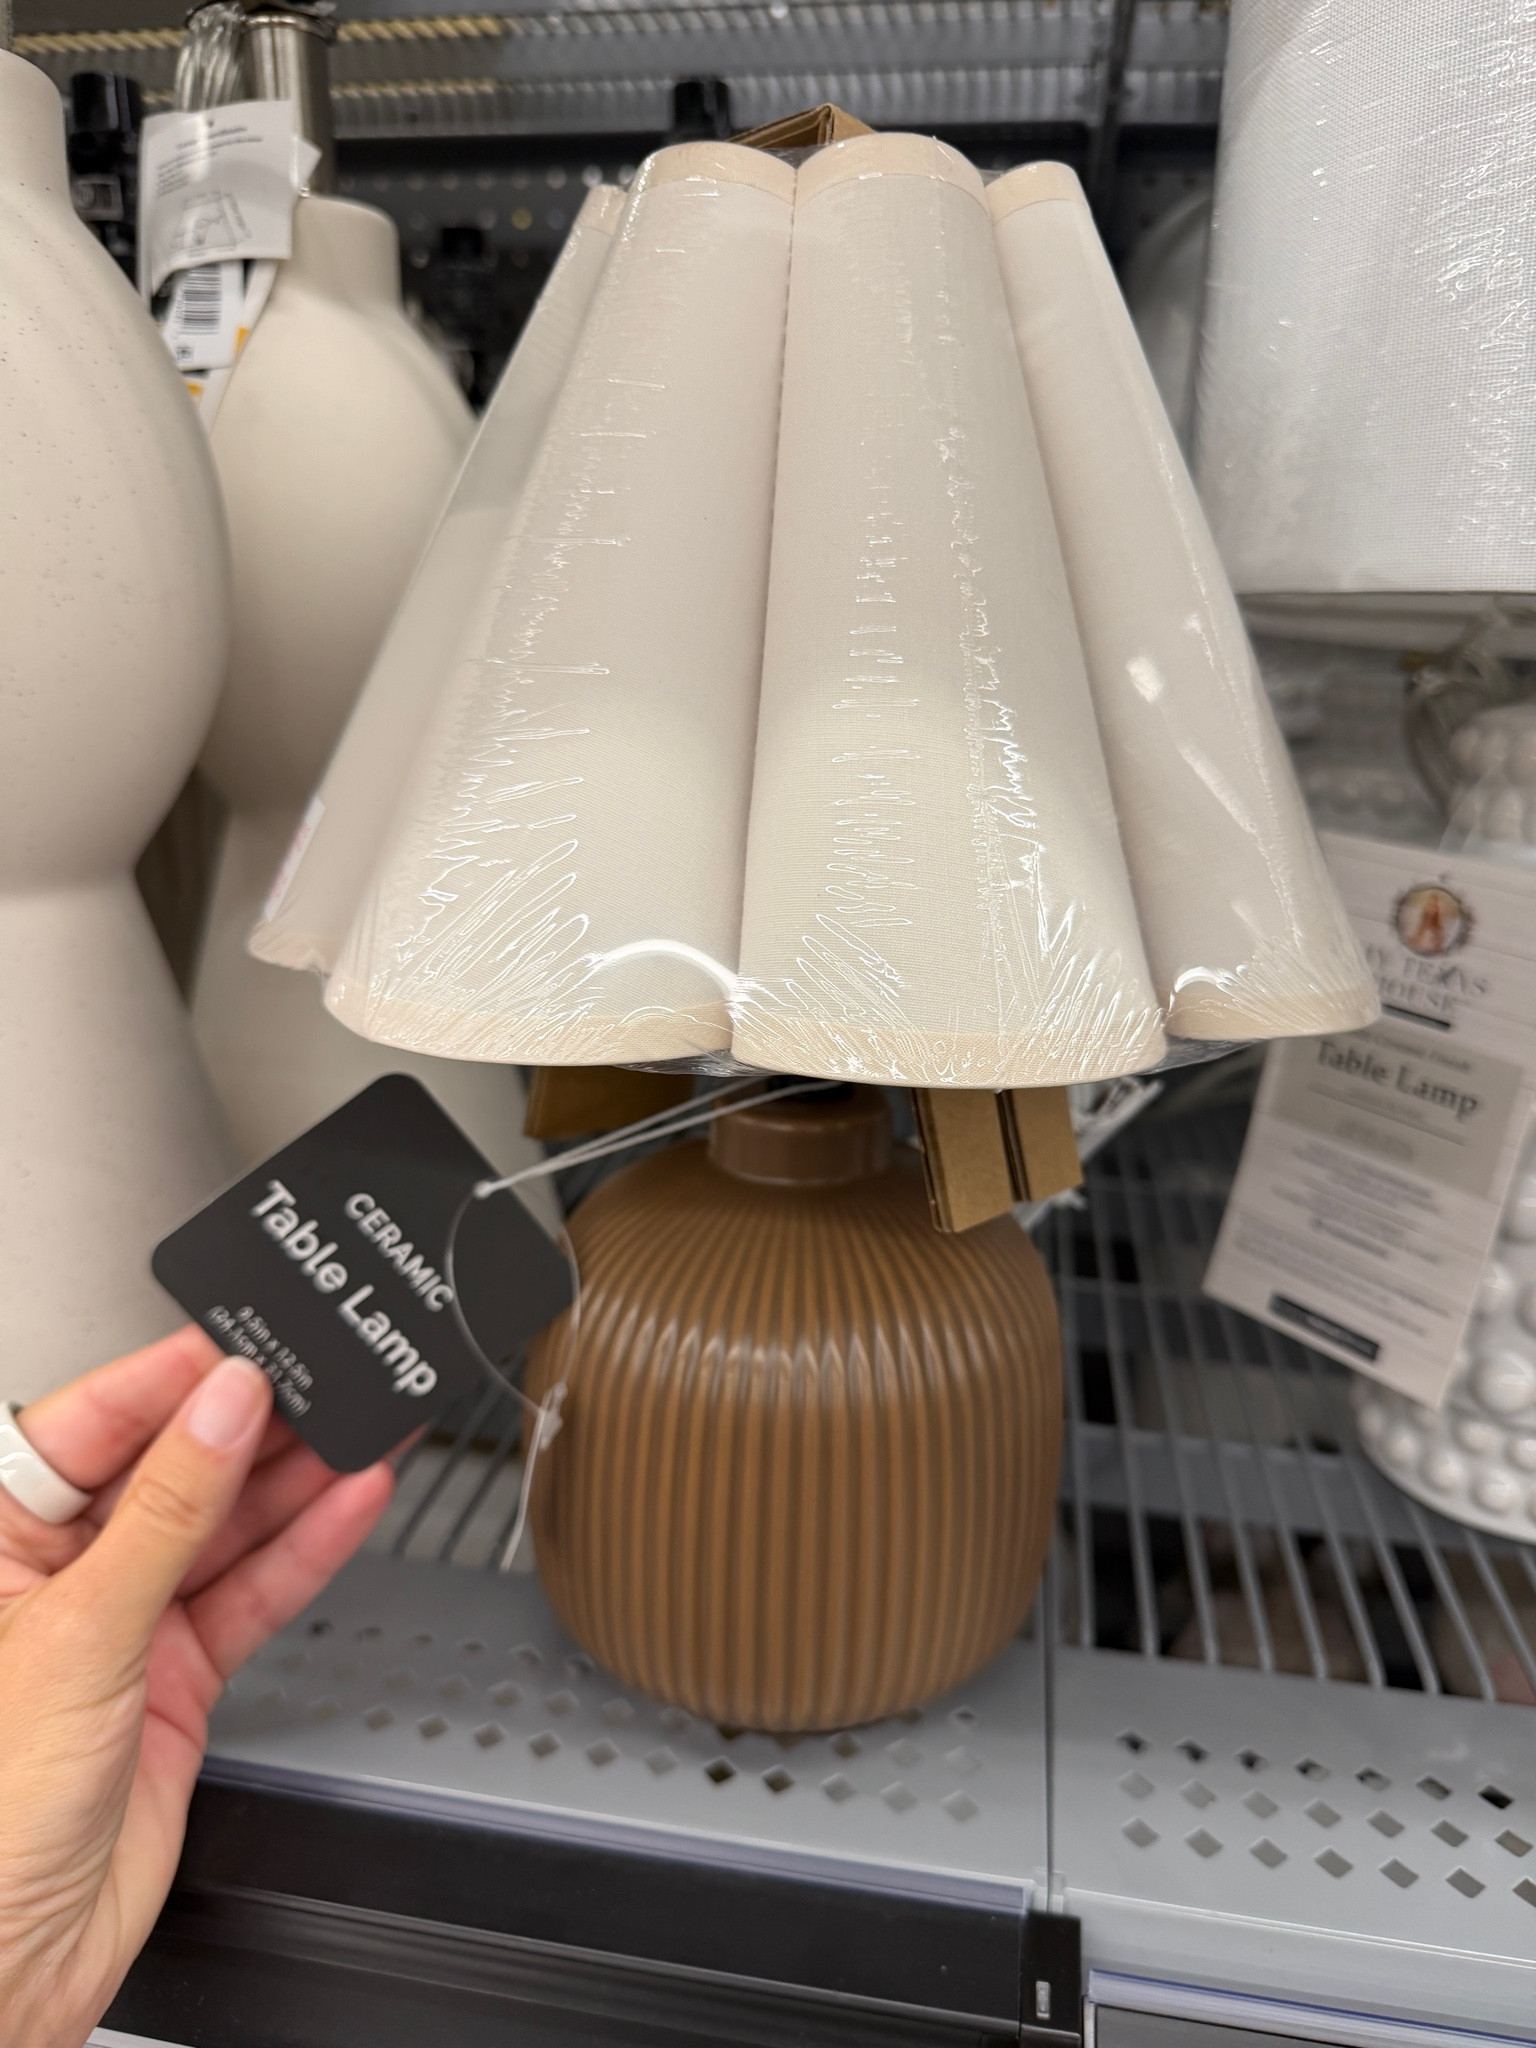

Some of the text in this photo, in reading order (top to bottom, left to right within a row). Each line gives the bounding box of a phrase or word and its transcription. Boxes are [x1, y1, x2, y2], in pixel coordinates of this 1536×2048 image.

[1316, 1038, 1391, 1087] Table
[1394, 1063, 1480, 1123] Lamp
[251, 1179, 438, 1397] Table Lamp
[344, 1192, 454, 1313] CERAMIC
